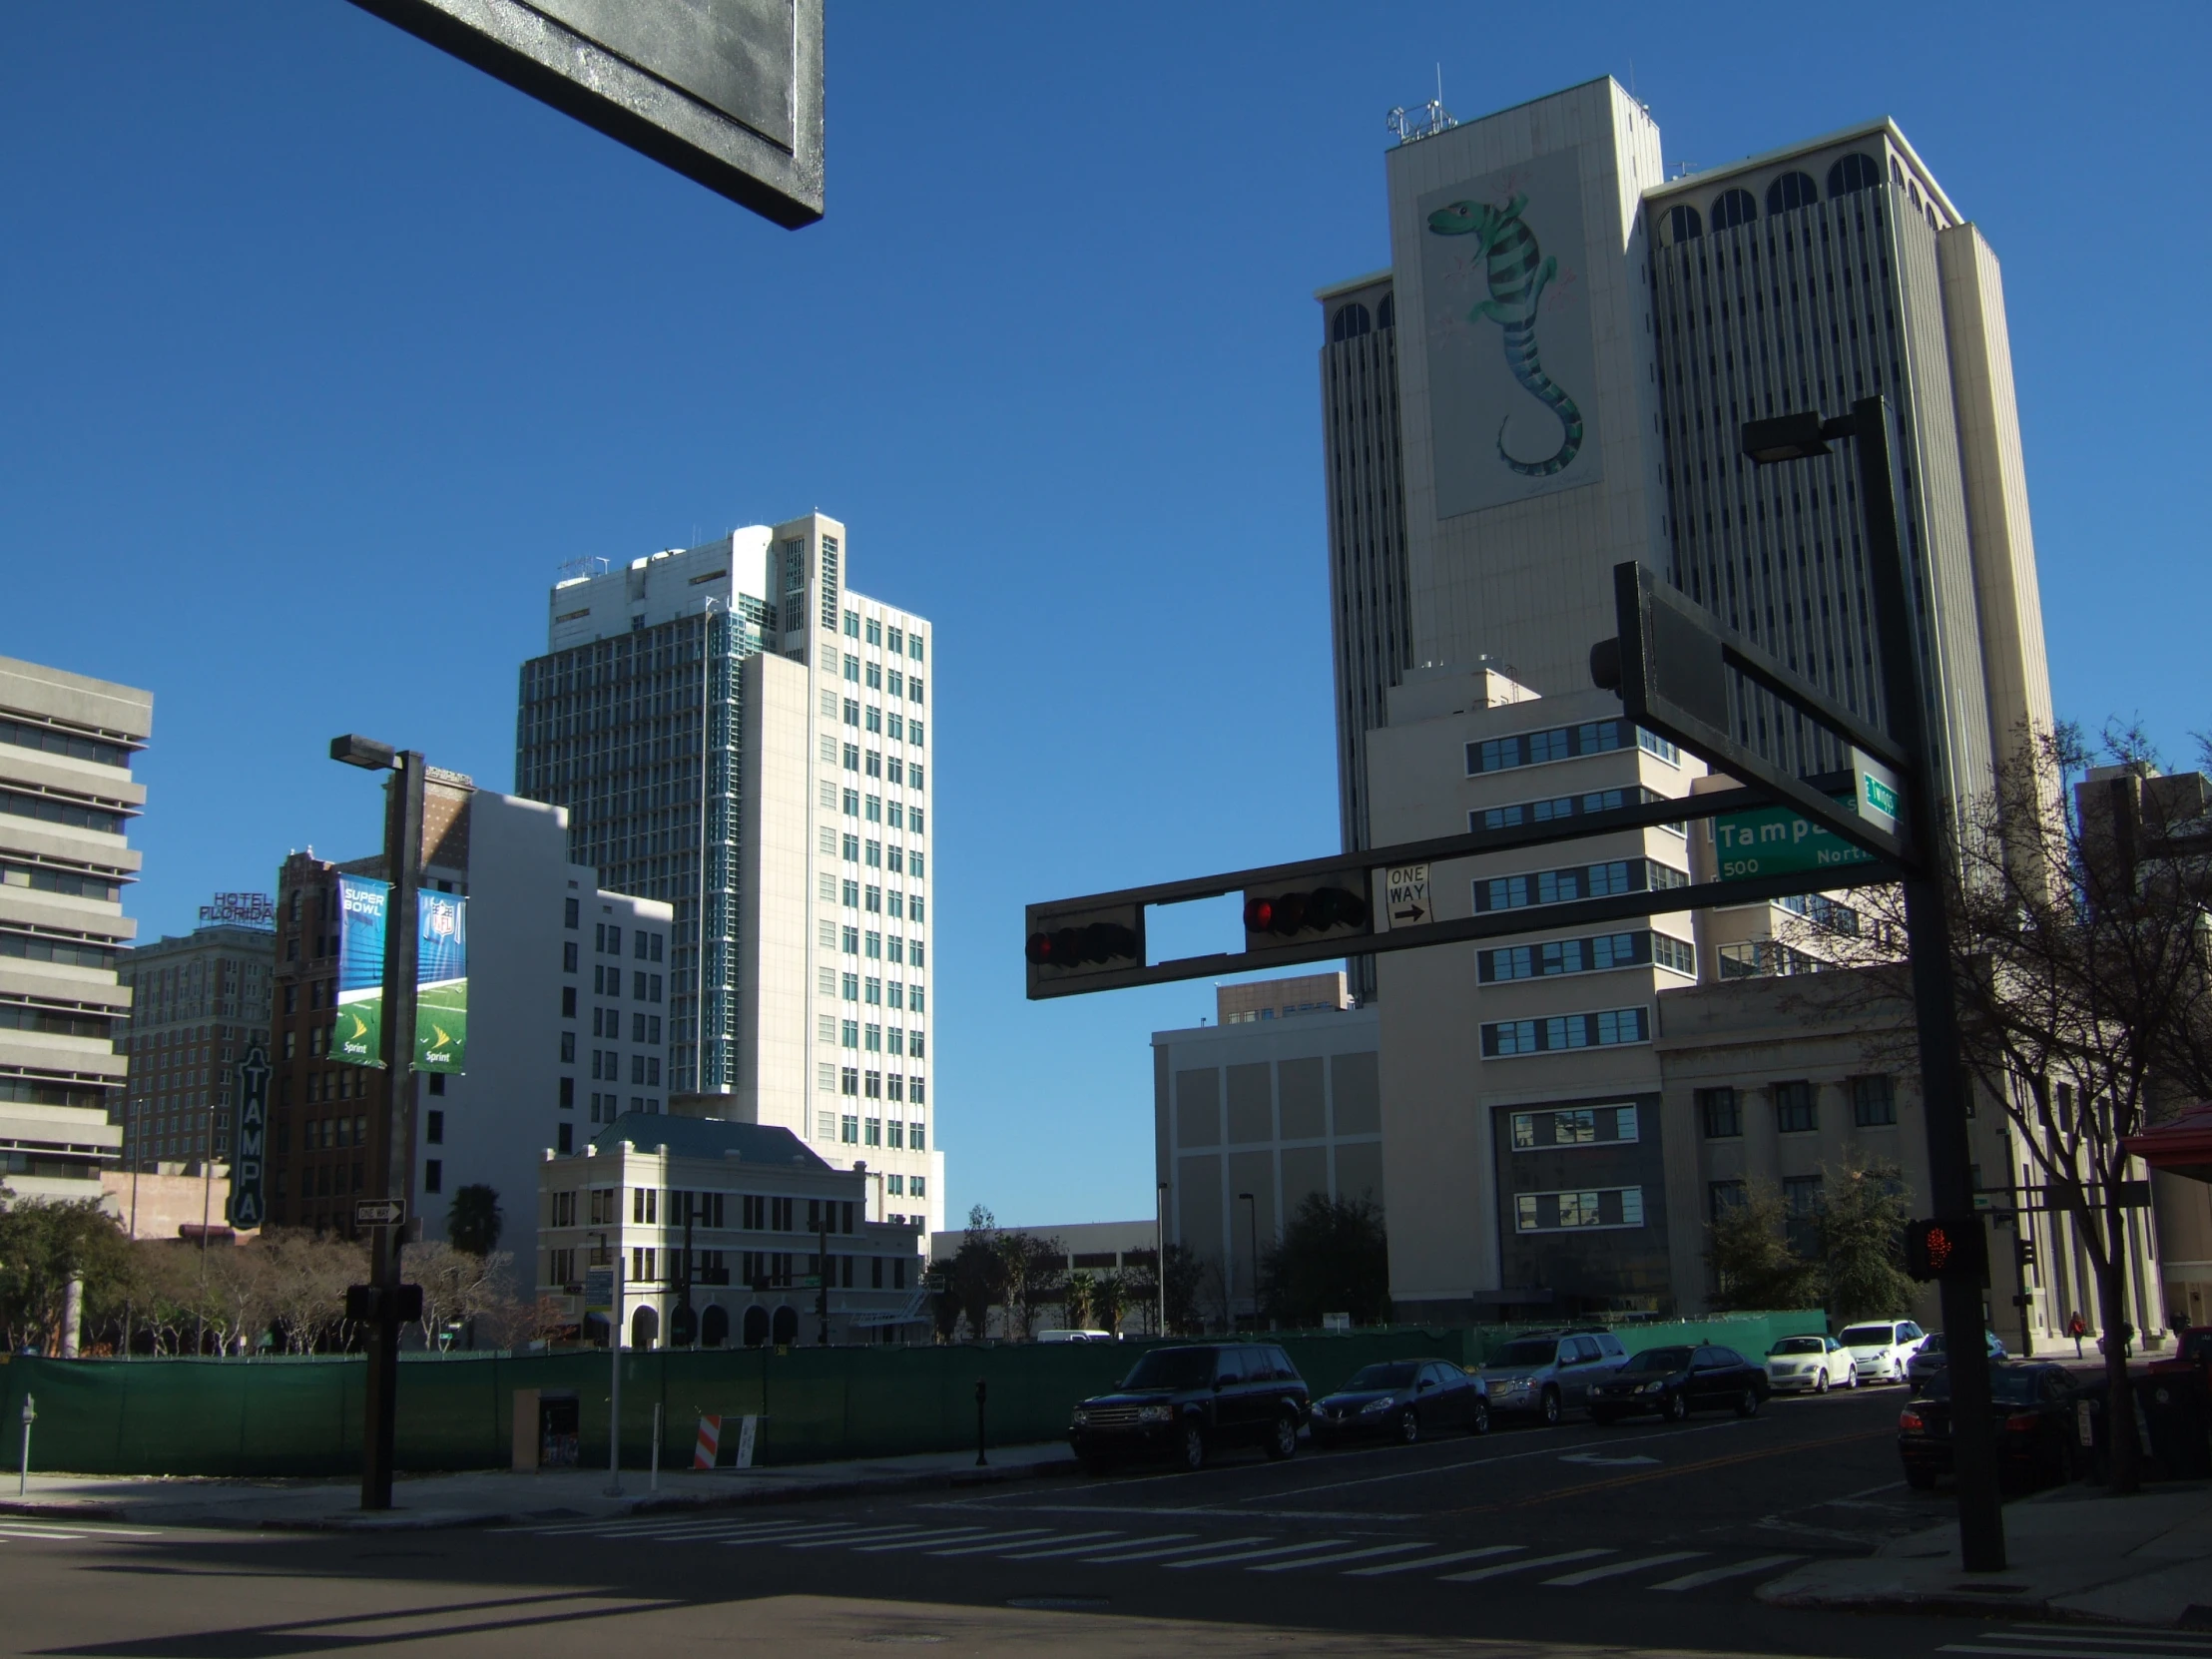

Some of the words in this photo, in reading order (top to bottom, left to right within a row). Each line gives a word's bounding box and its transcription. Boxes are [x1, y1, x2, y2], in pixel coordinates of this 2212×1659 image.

[1871, 779, 1894, 814] Twiggs
[1391, 866, 1423, 884] ONE
[1723, 858, 1759, 876] 500
[215, 892, 273, 906] HOTEL
[344, 888, 384, 905] SUPER
[1390, 883, 1424, 903] WAY
[201, 906, 274, 919] FLORIDA
[343, 899, 381, 915] BOWL
[433, 913, 451, 931] NFL
[343, 1041, 367, 1055] Sprint
[425, 1050, 451, 1064] Sprint
[240, 1067, 265, 1219] TAMPA
